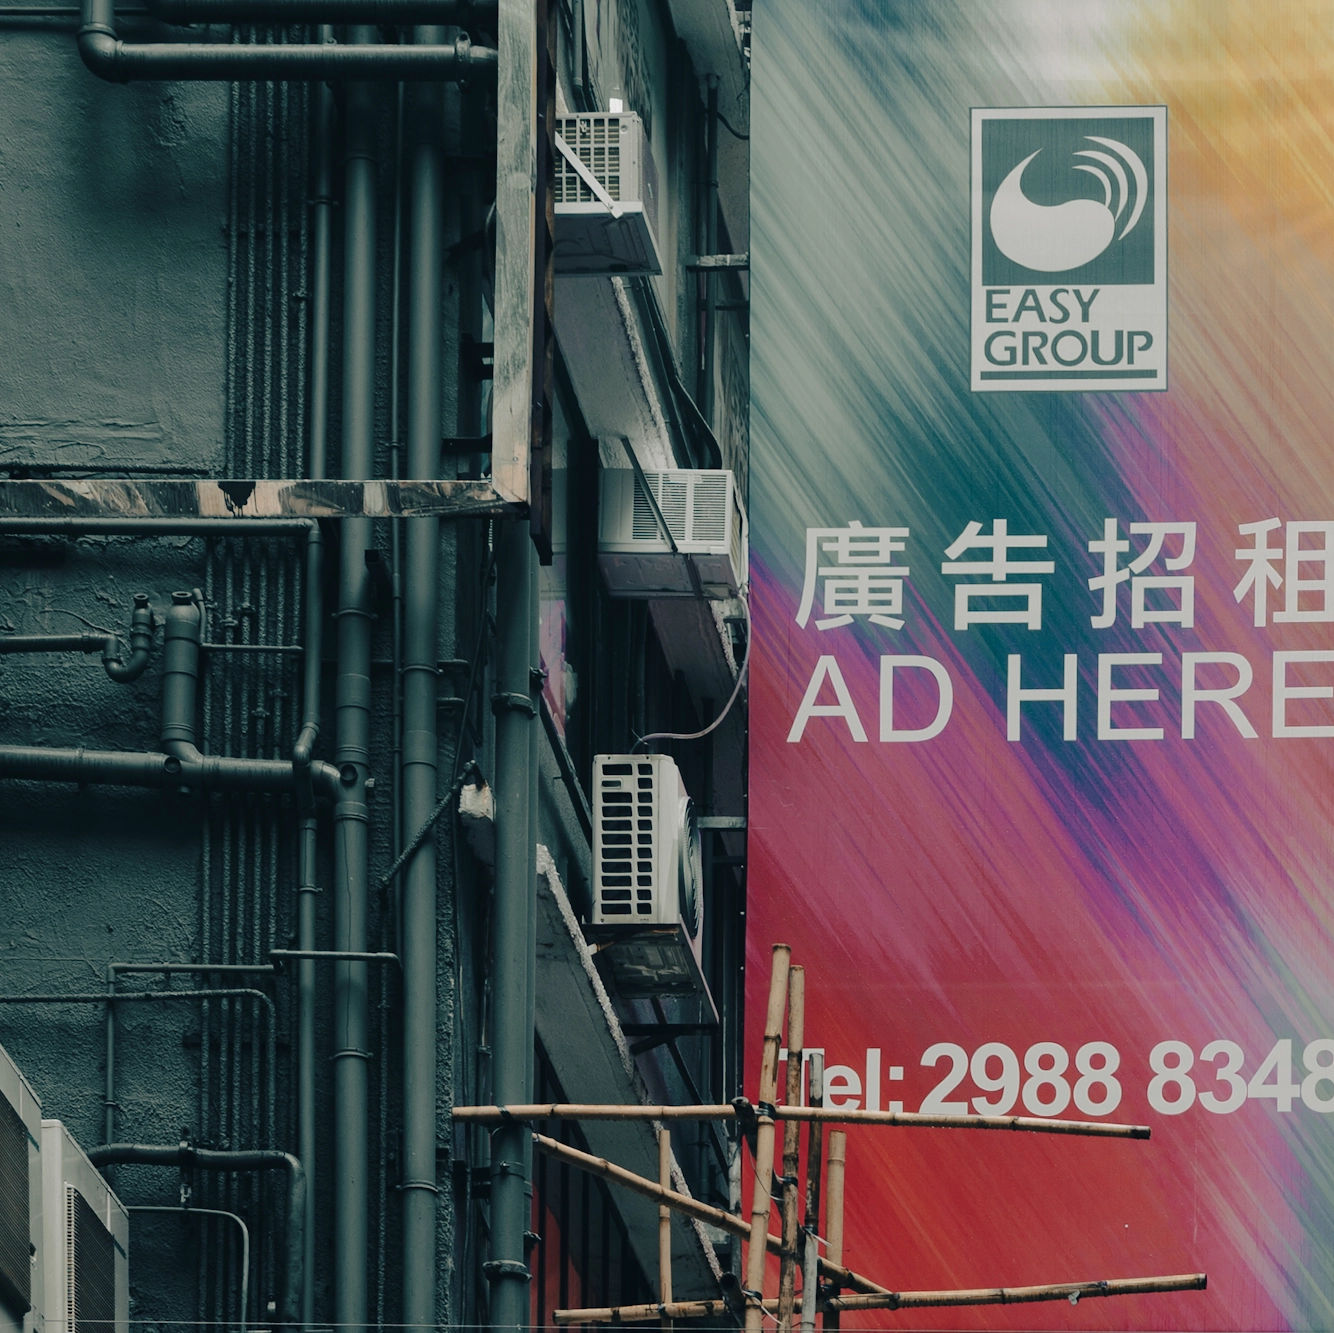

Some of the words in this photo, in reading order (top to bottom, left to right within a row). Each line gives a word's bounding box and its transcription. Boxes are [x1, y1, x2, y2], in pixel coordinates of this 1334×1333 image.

[984, 288, 1100, 324] EASY
[984, 330, 1154, 367] GROUP
[786, 654, 953, 743] AD
[919, 1041, 1122, 1117] 2988
